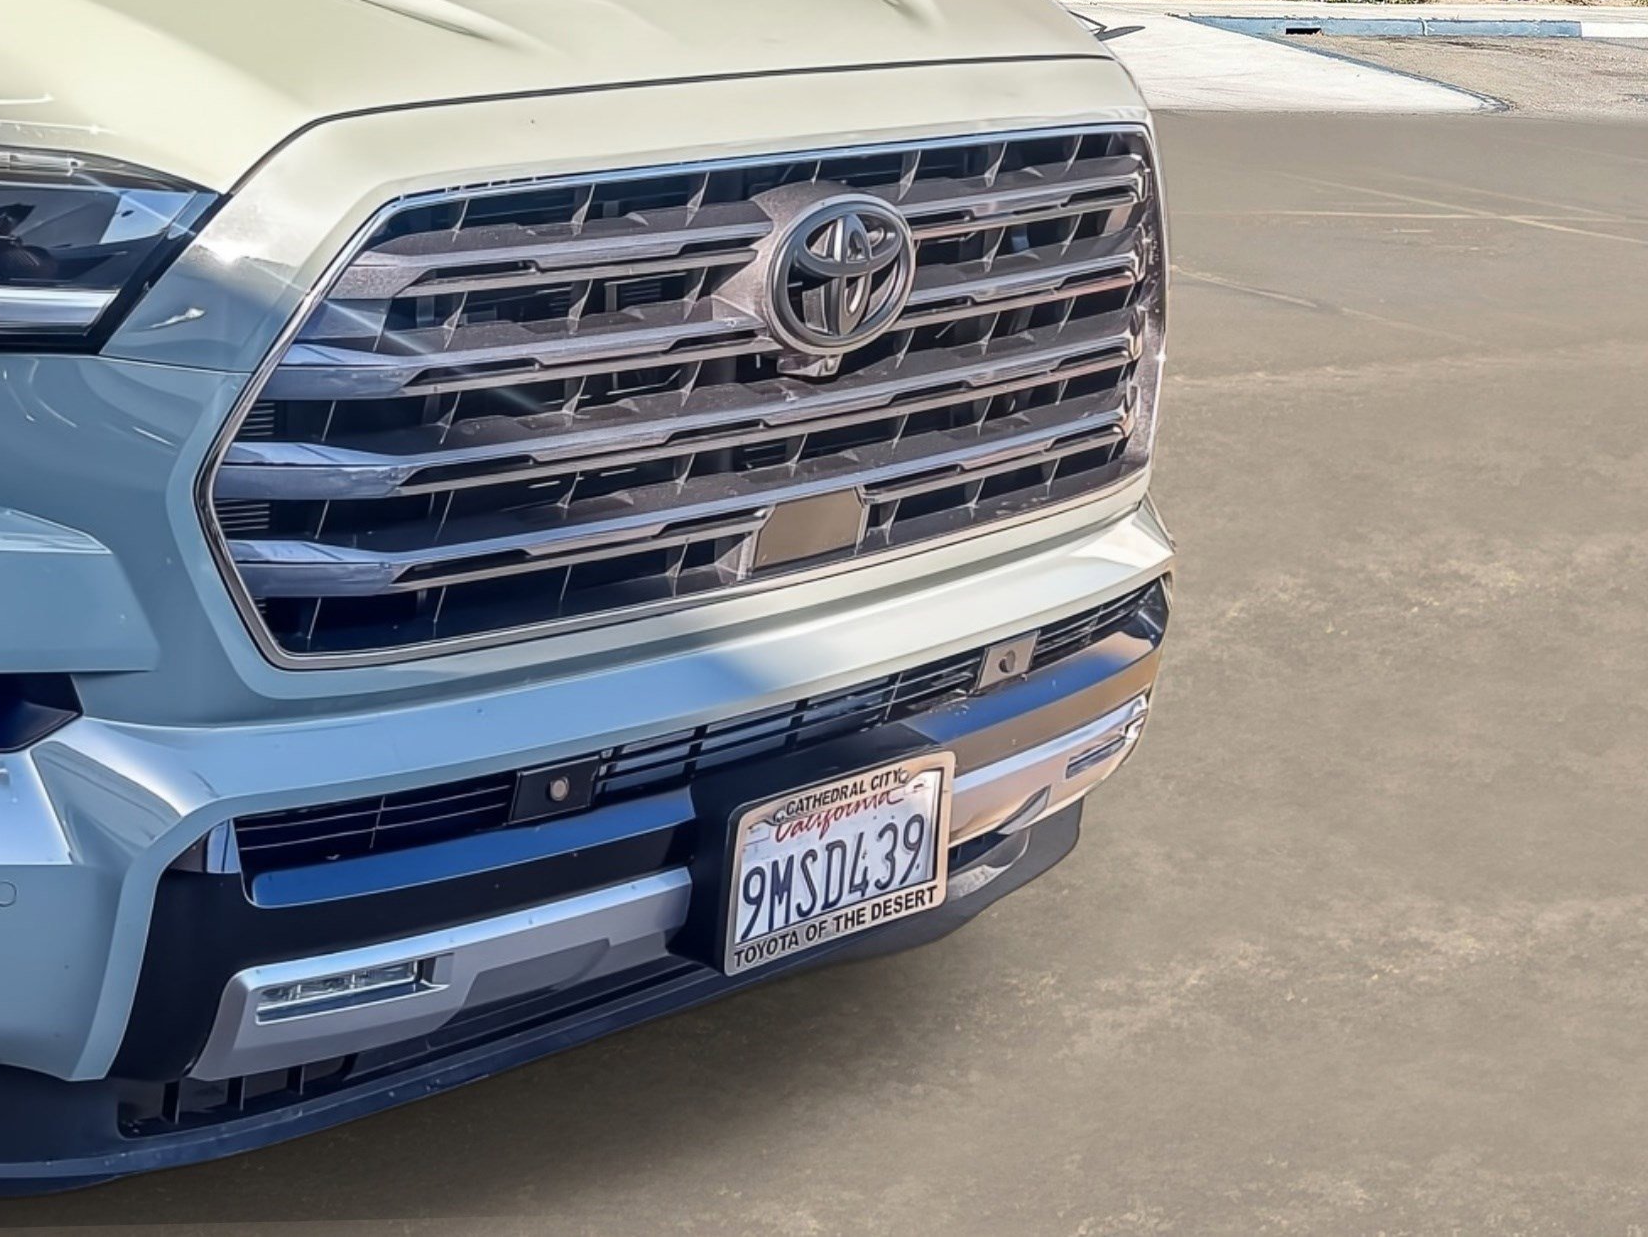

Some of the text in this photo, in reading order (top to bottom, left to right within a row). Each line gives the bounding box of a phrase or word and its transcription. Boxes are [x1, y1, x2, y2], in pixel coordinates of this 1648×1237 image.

[786, 768, 901, 816] CATHEDRAL CITY
[741, 813, 925, 941] 9MSD439
[734, 885, 937, 967] TOYOTA OF THE DESERT
